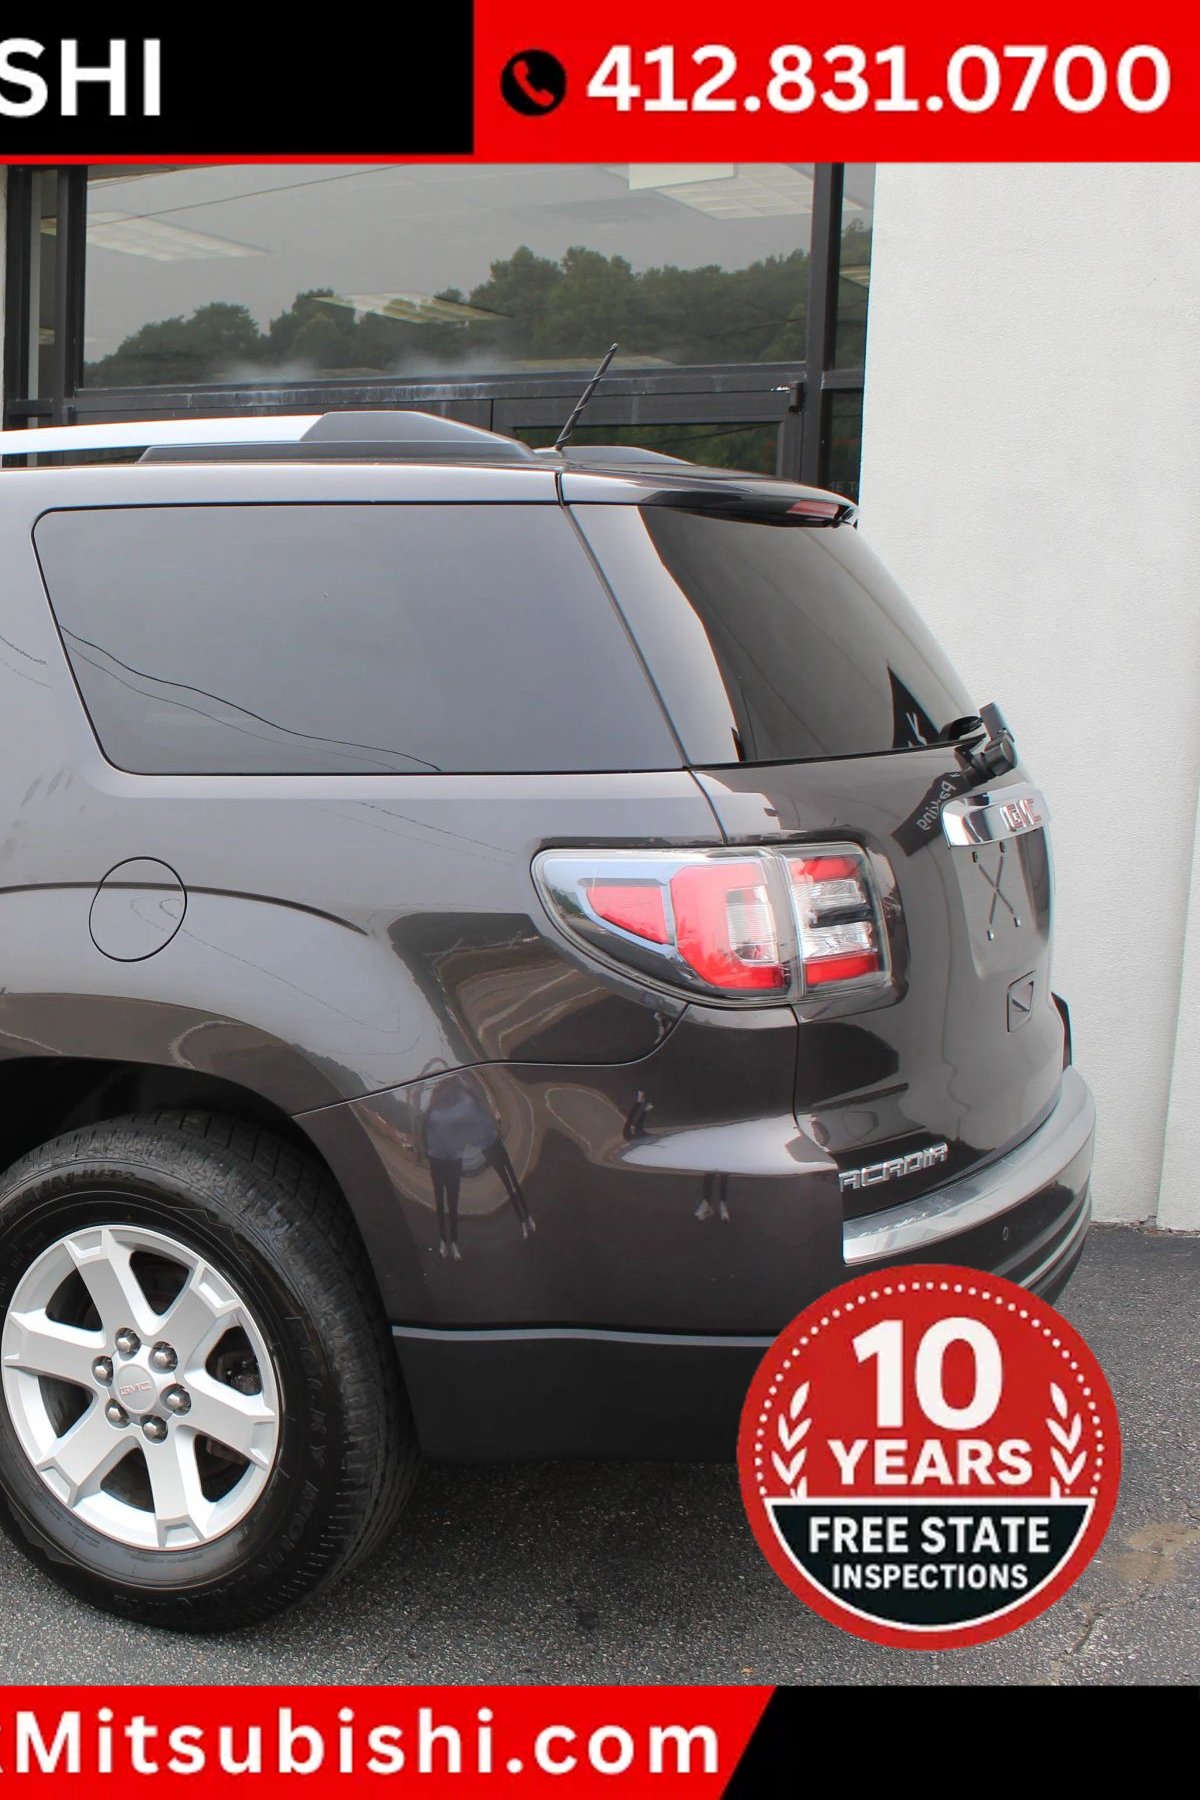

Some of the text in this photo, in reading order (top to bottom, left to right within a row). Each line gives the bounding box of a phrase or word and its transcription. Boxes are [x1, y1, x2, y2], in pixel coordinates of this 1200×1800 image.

[1000, 798, 1042, 832] GMC
[839, 1143, 948, 1192] ACADIA
[119, 1381, 152, 1396] GMC
